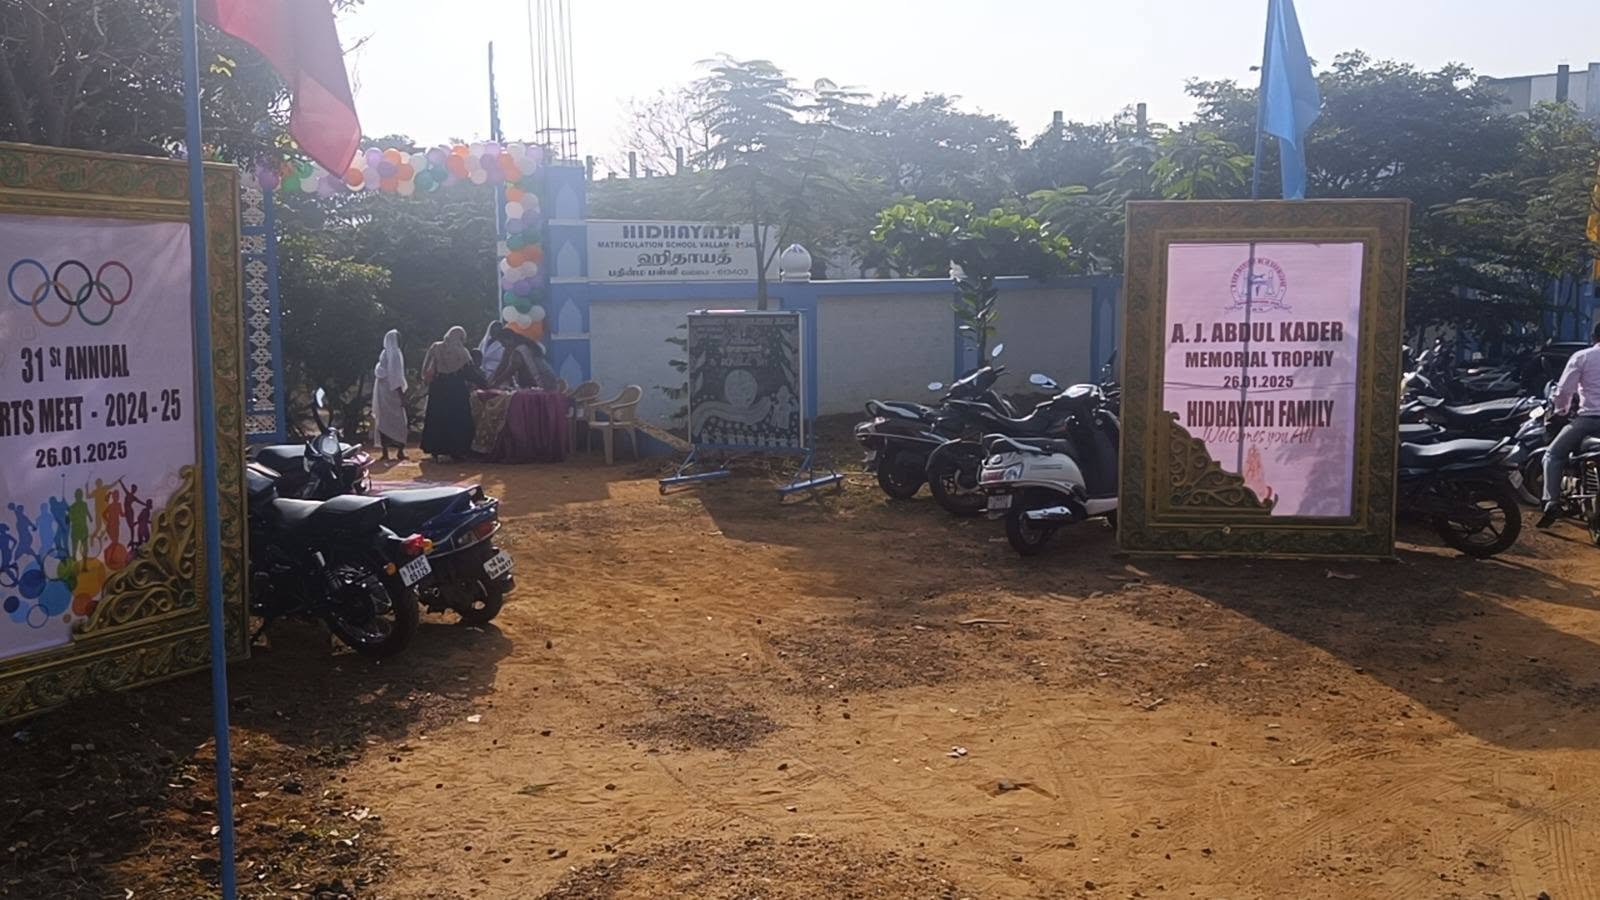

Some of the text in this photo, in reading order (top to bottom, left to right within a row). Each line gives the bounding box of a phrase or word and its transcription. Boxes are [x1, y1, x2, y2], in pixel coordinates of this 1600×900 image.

[597, 241, 663, 249] MATRICULATION
[665, 241, 697, 249] SCHOOL
[700, 241, 730, 249] VALLAM
[1171, 321, 1343, 343] A. J. ABDUL KADER
[65, 344, 130, 381] ANNUAL
[1185, 351, 1334, 368] MEMORIAL TROPHY
[1223, 375, 1294, 388] 26.01.2025
[39, 396, 83, 433] MEET
[1187, 400, 1334, 427] HIDHAYATH FAMILY
[36, 440, 127, 469] 26.01.2025
